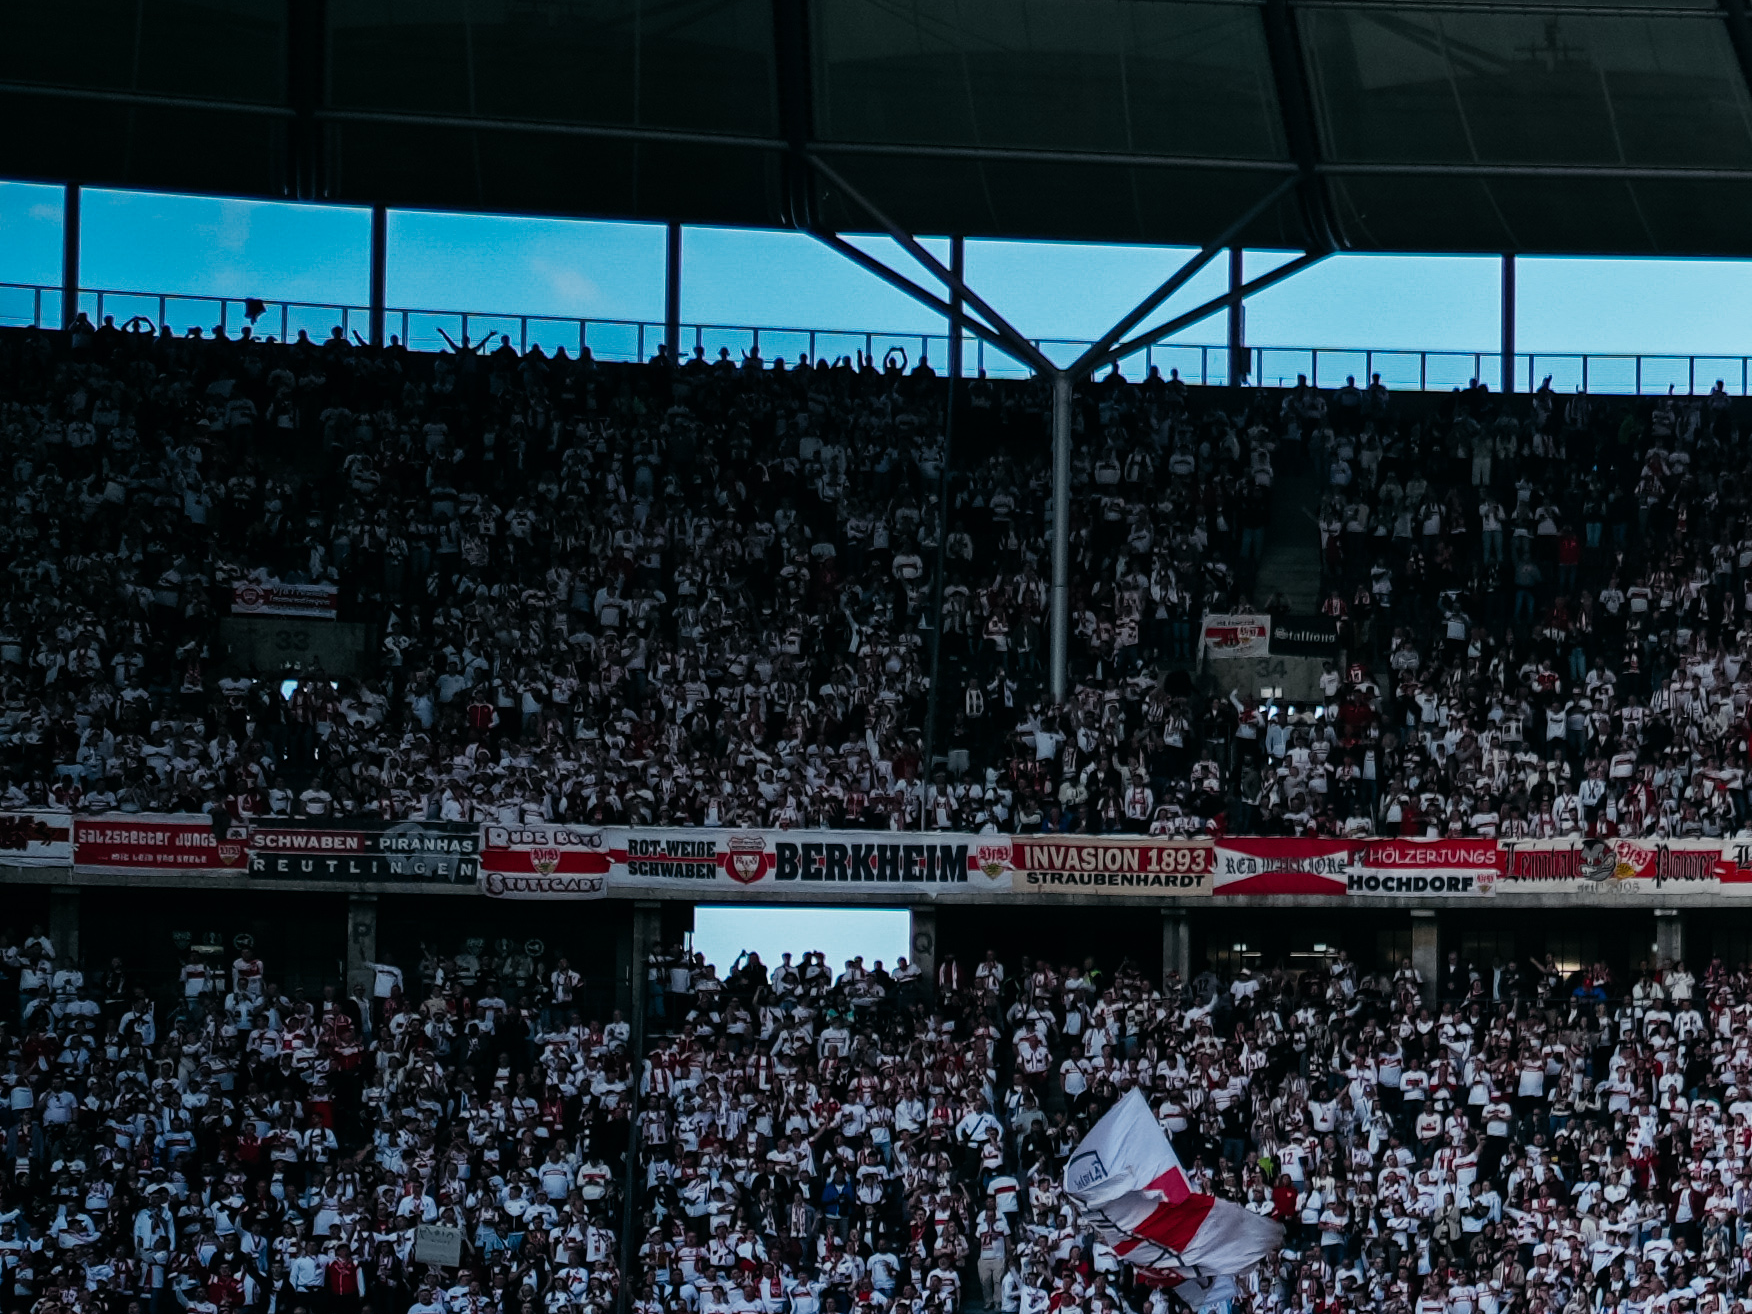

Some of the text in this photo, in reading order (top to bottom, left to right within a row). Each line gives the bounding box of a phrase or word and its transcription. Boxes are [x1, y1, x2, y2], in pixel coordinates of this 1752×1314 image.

[253, 833, 474, 854] SCHWABEN PIRANHAS
[775, 842, 969, 882] BERKHEIM
[1023, 844, 1207, 873] INVASION 1893
[1224, 856, 1258, 875] RED
[1369, 846, 1497, 866] HÖLZERJUNGS
[252, 858, 474, 878] REUTLINGEN
[627, 861, 717, 880] SCHWABEN
[1654, 843, 1716, 890] Power
[1025, 871, 1205, 888] STRAUBENHARDT
[1347, 875, 1474, 893] HOCHDORF
